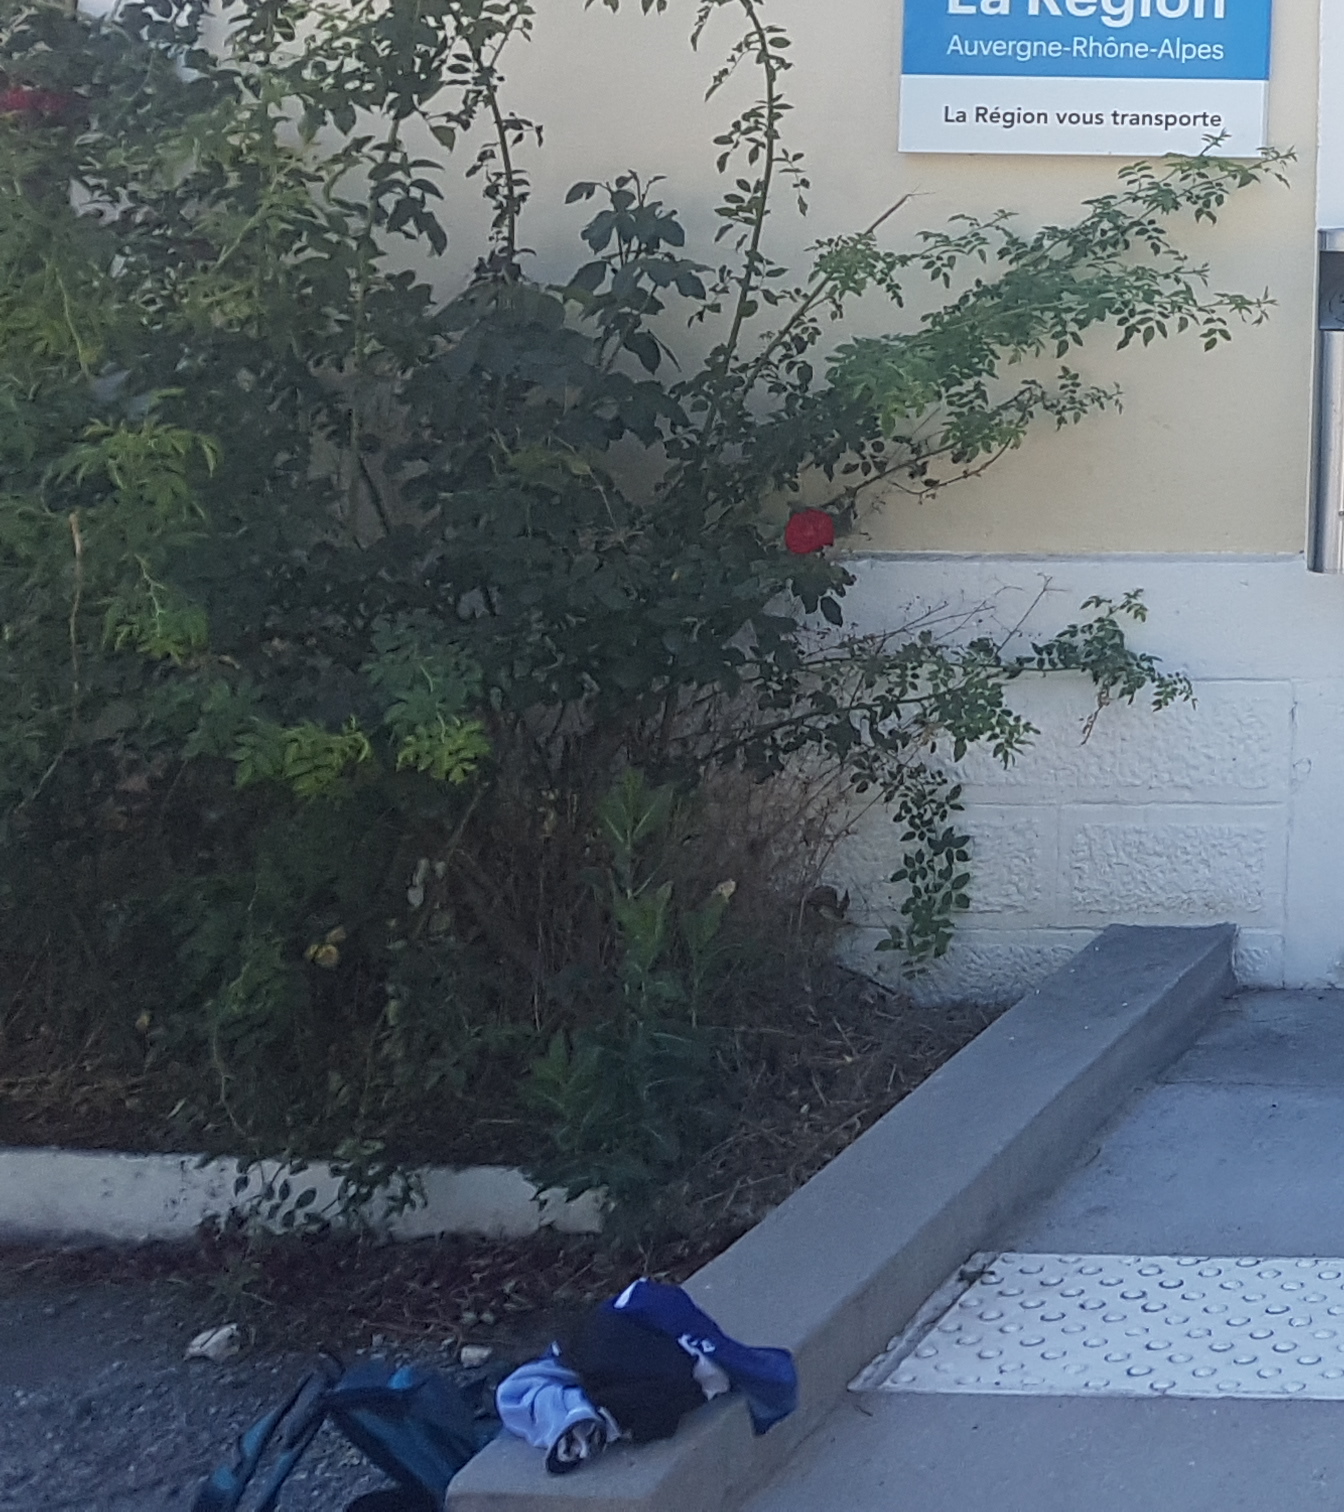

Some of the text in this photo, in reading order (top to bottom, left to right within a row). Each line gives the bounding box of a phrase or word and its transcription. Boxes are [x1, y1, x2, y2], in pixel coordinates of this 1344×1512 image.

[946, 34, 1225, 64] Auvergne-Rhône-Alpes
[944, 105, 1223, 132] La Région vous transporte
